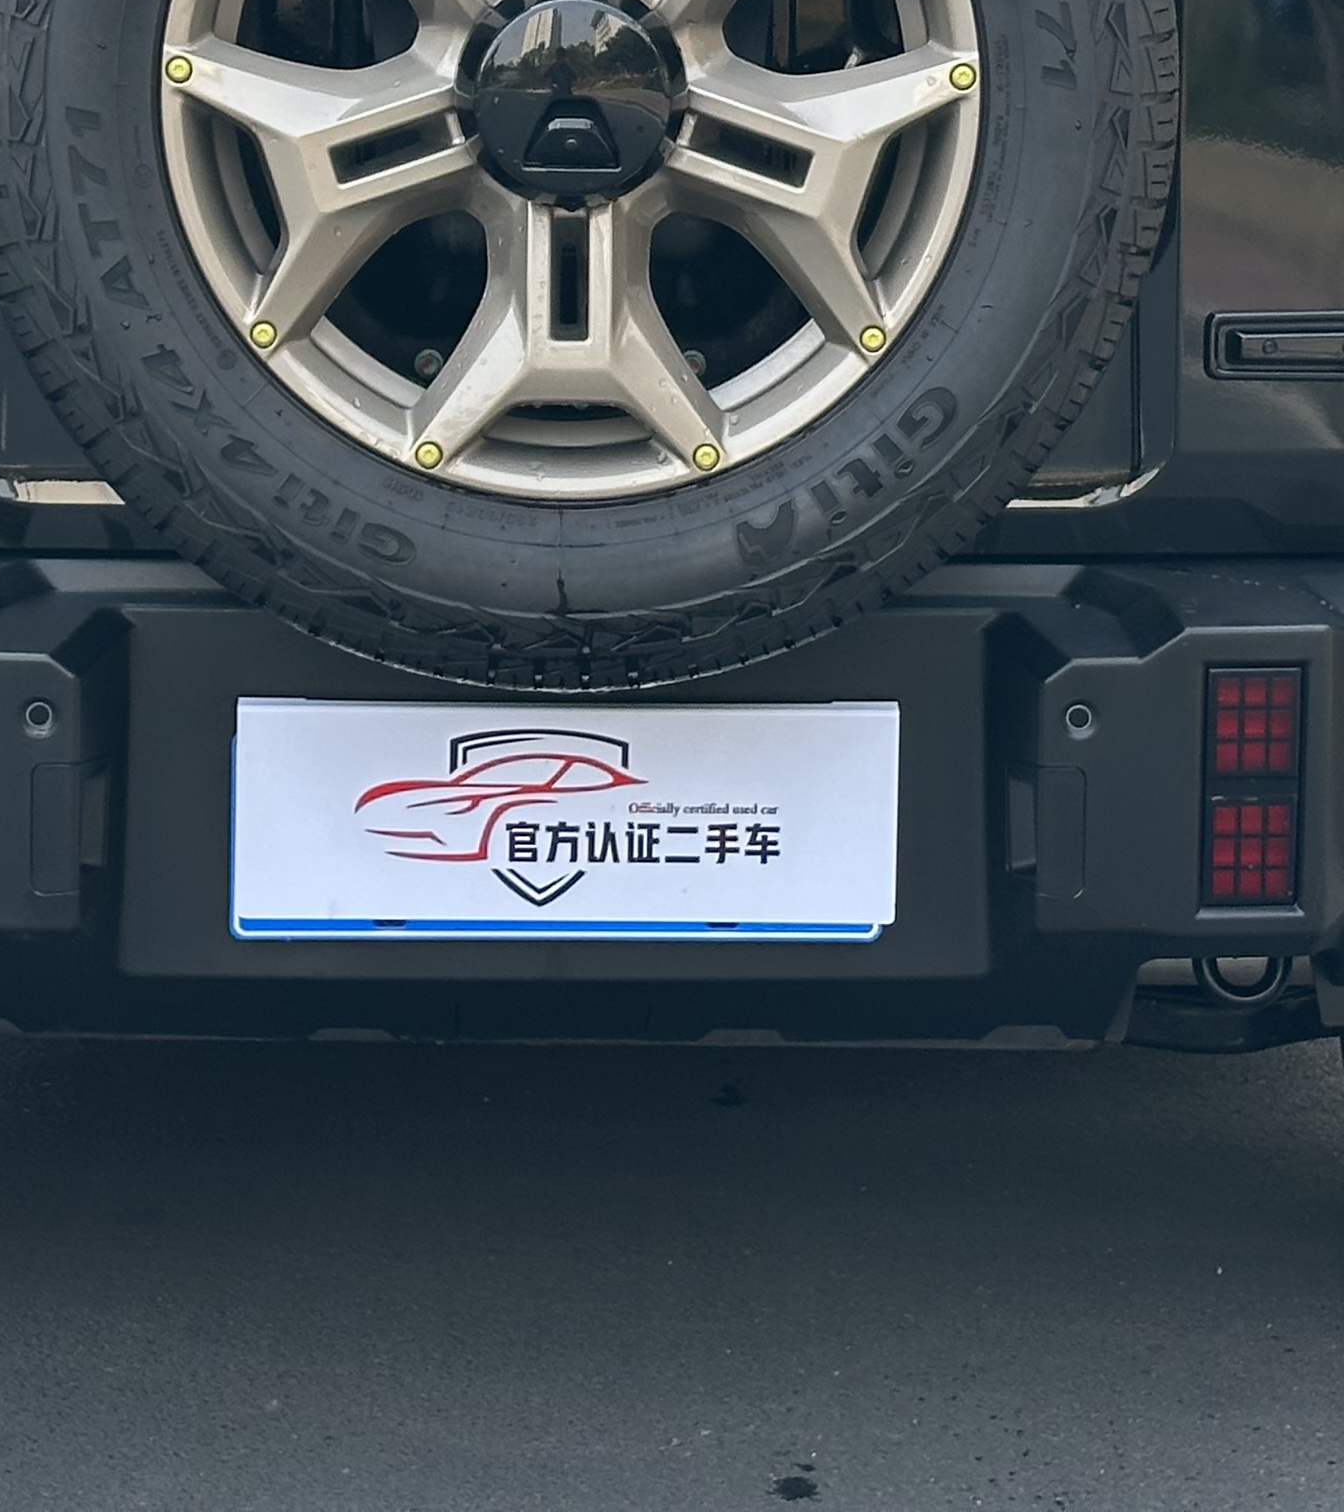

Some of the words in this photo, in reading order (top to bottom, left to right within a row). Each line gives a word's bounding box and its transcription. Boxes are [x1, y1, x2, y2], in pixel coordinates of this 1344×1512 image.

[809, 386, 958, 527] Giti
[682, 802, 730, 815] certified
[732, 802, 758, 815] used
[760, 805, 780, 815] car
[505, 821, 781, 865] 官方认证二手车
